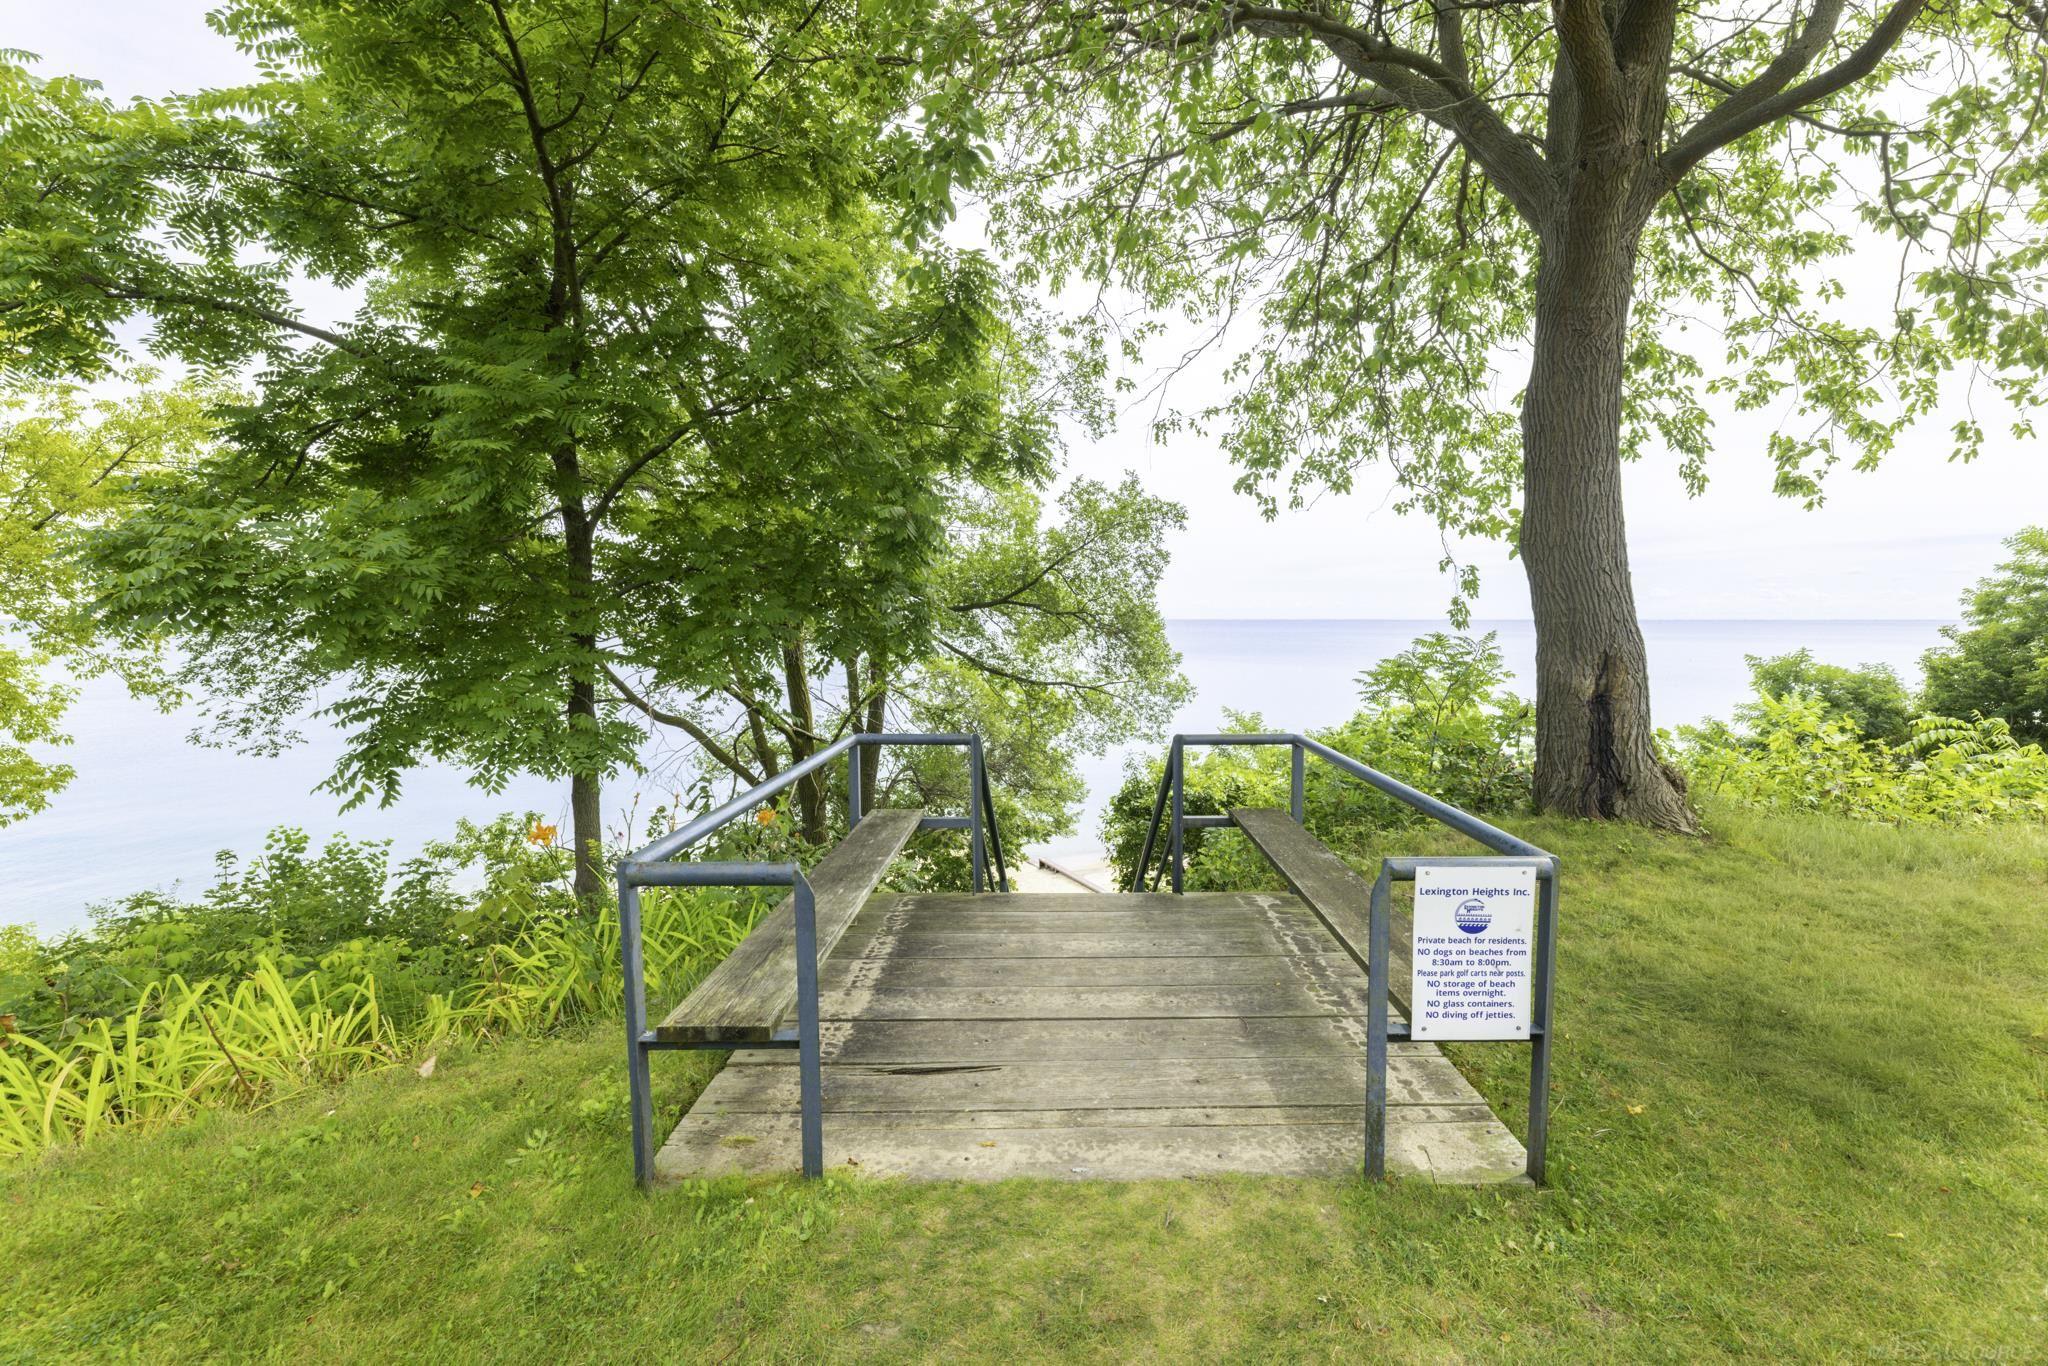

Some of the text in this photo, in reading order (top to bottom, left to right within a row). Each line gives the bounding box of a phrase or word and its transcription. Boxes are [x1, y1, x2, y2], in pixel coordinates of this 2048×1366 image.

[1419, 887, 1530, 898] Lexington Heights Inc.
[1417, 937, 1527, 945] Private beach for residents.
[1417, 948, 1430, 956] NO
[1433, 948, 1453, 958] dogs
[1468, 948, 1503, 956] beaches
[1506, 948, 1527, 956] from
[1477, 959, 1512, 968] 8:00pm.
[1417, 969, 1438, 977] Please
[1439, 969, 1455, 978] park
[1456, 969, 1469, 978] golf
[1505, 970, 1526, 978] posts.
[1426, 980, 1516, 990] NO storage of beach
[1435, 989, 1506, 998] items overnight.
[1442, 1000, 1464, 1009] glass
[1467, 1000, 1515, 1008] containers.
[1425, 1011, 1516, 1020] NO diving off jetties.
